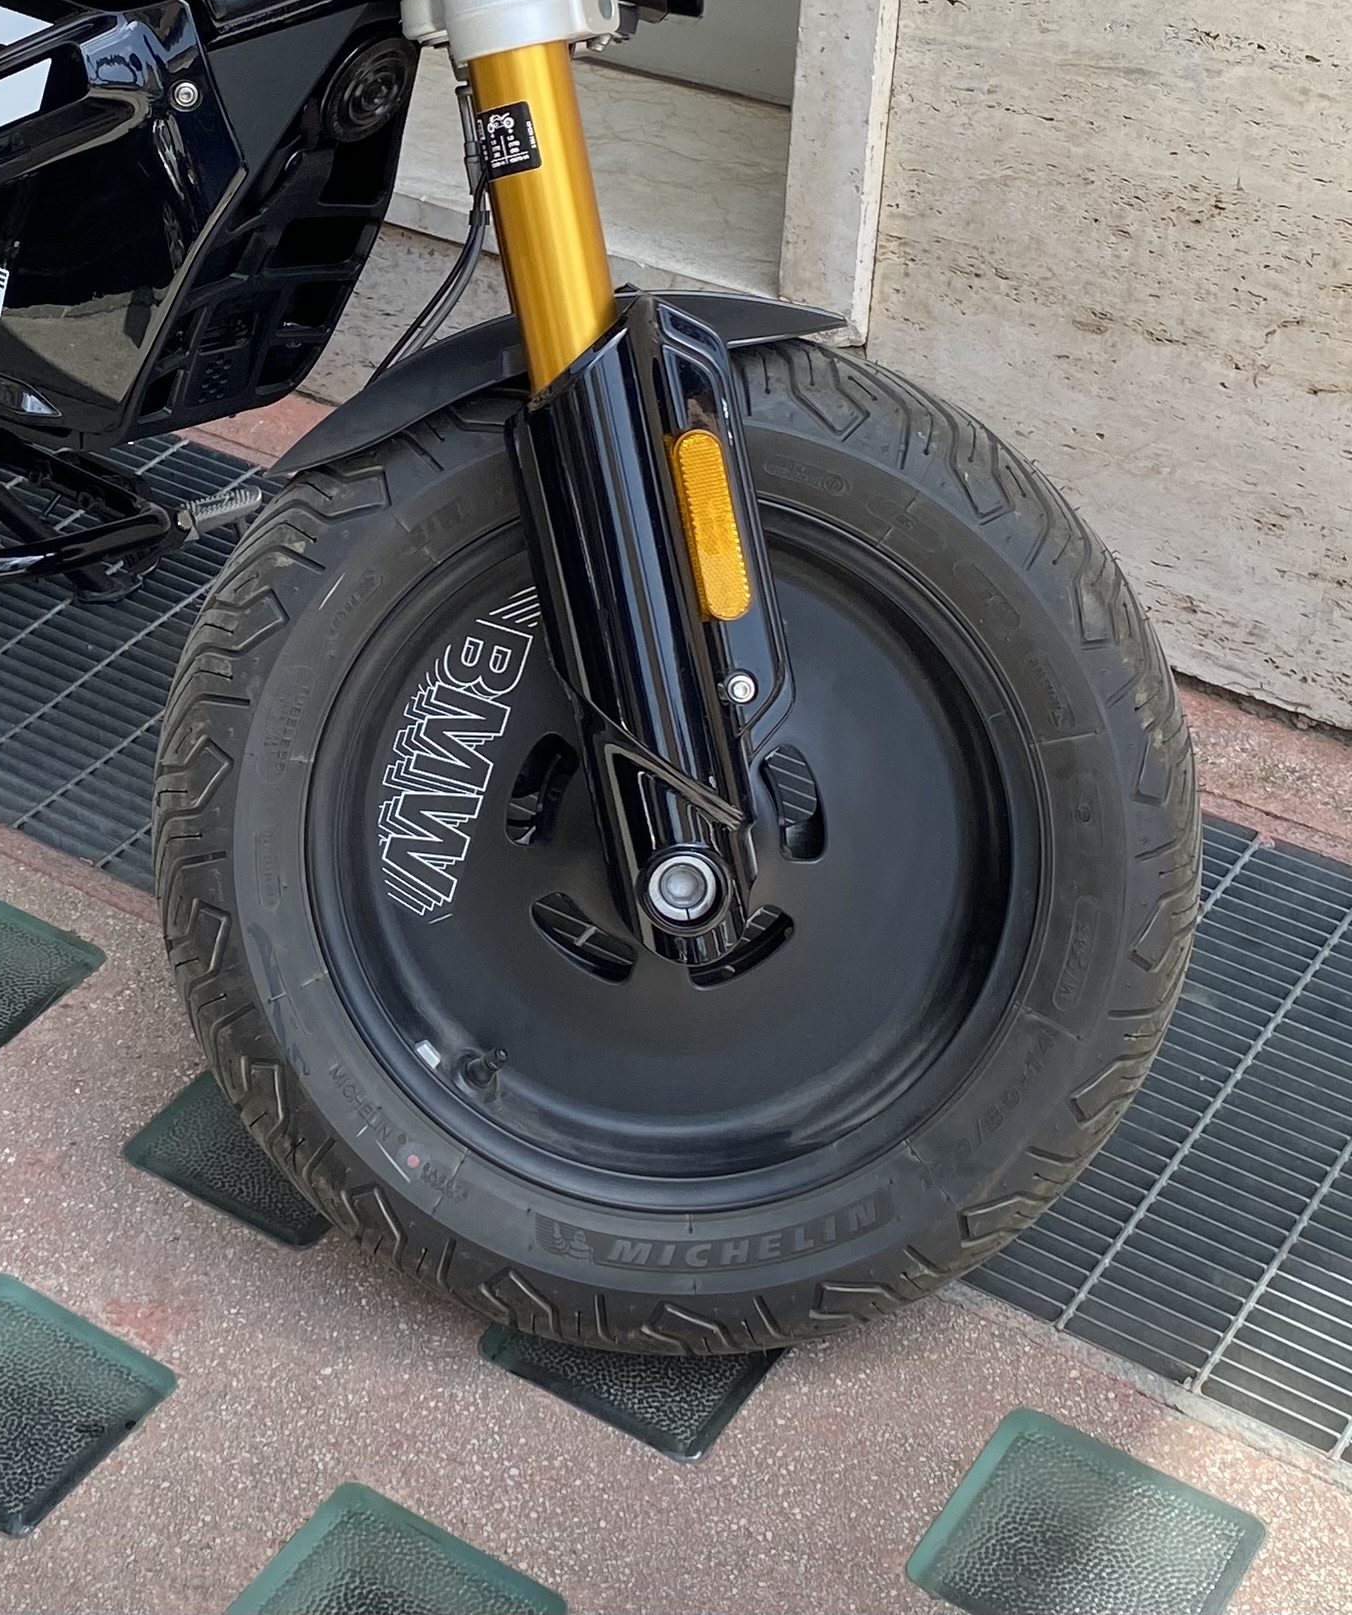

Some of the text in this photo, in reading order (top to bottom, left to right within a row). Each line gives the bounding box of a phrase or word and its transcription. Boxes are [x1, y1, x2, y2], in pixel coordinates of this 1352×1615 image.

[378, 616, 535, 916] BMW
[329, 1062, 391, 1142] MICHELIN
[606, 1197, 878, 1269] MICHELIN
